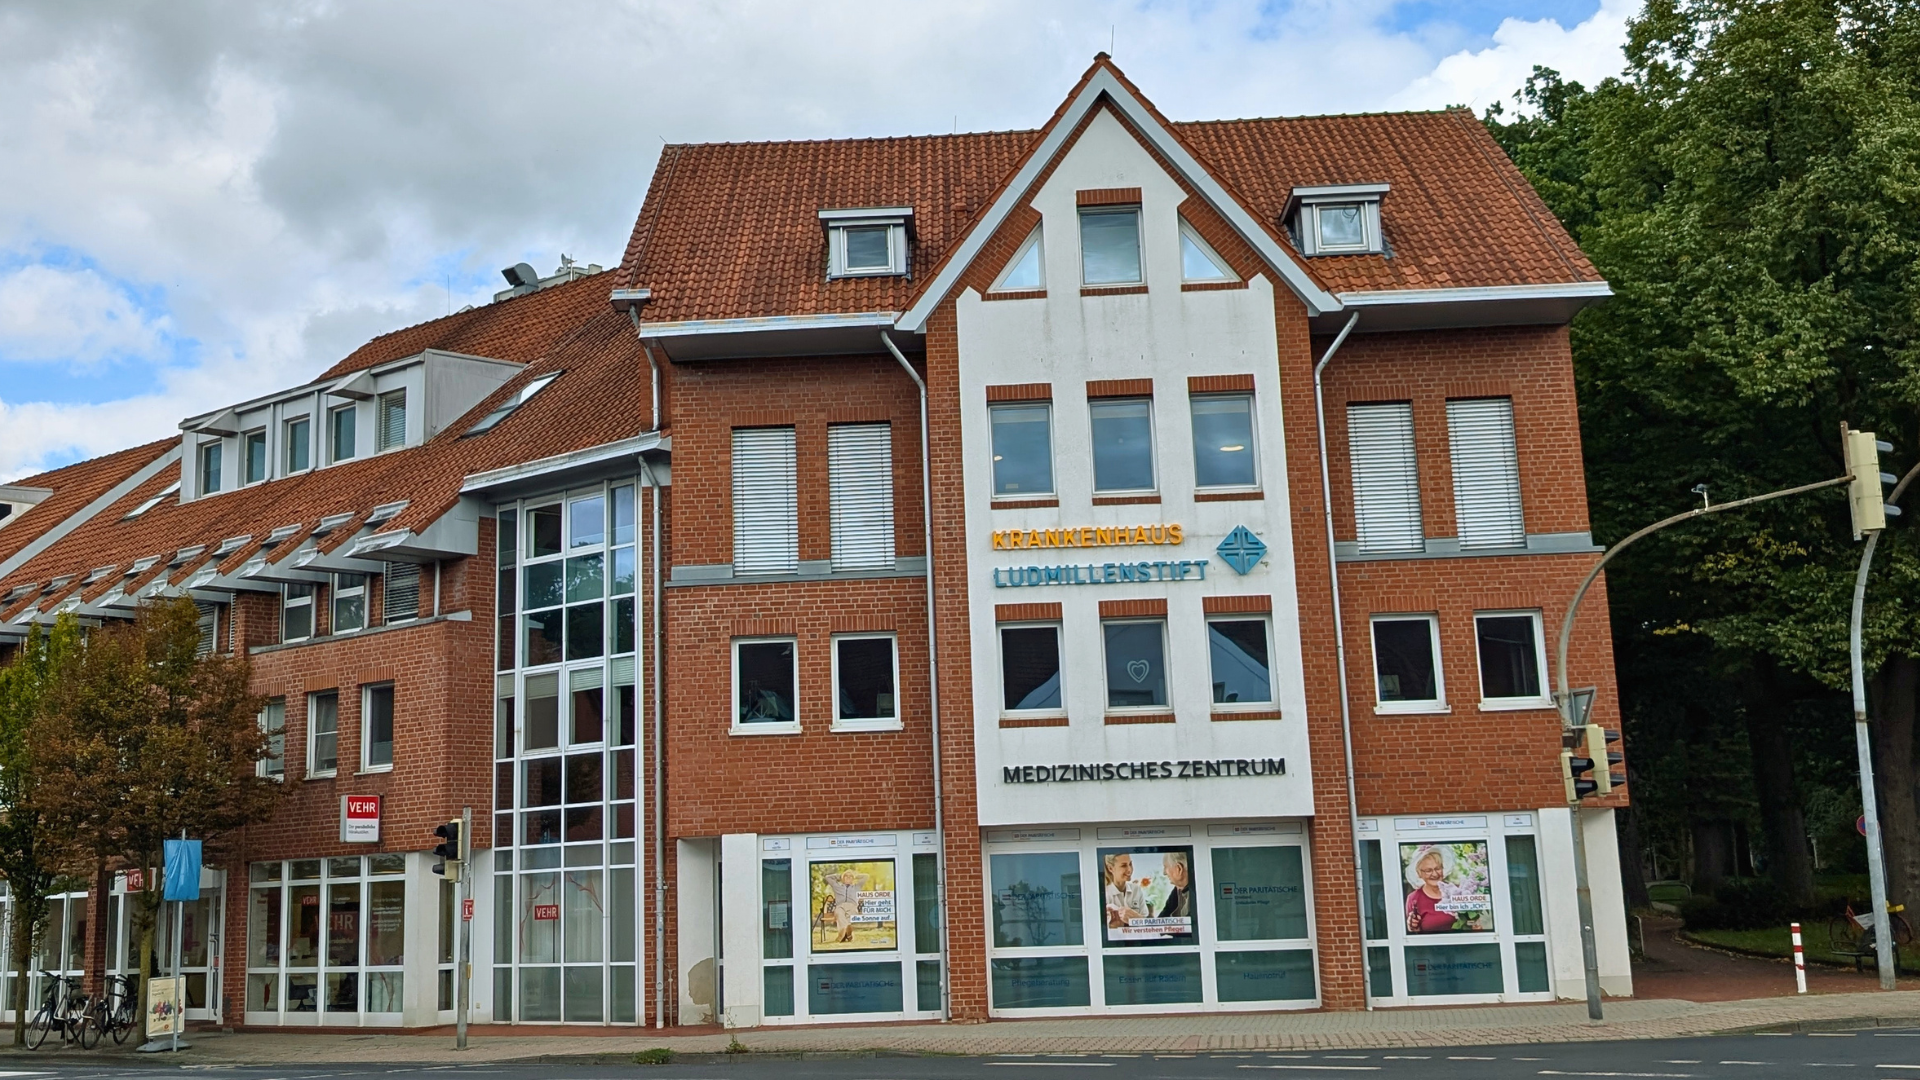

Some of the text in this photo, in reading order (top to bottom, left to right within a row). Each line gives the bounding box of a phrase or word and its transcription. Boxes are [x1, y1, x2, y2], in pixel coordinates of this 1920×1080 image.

[991, 524, 1183, 550] KRANKENHAUS
[994, 560, 1209, 587] LUDMILLENSTIFT
[1003, 758, 1286, 783] MEDIZINISCHES ZENTRUM
[349, 801, 376, 813] VEHR
[129, 873, 144, 887] VEH
[1234, 886, 1248, 894] DER
[536, 907, 557, 918] VEHR
[1164, 925, 1185, 933] Pflege!
